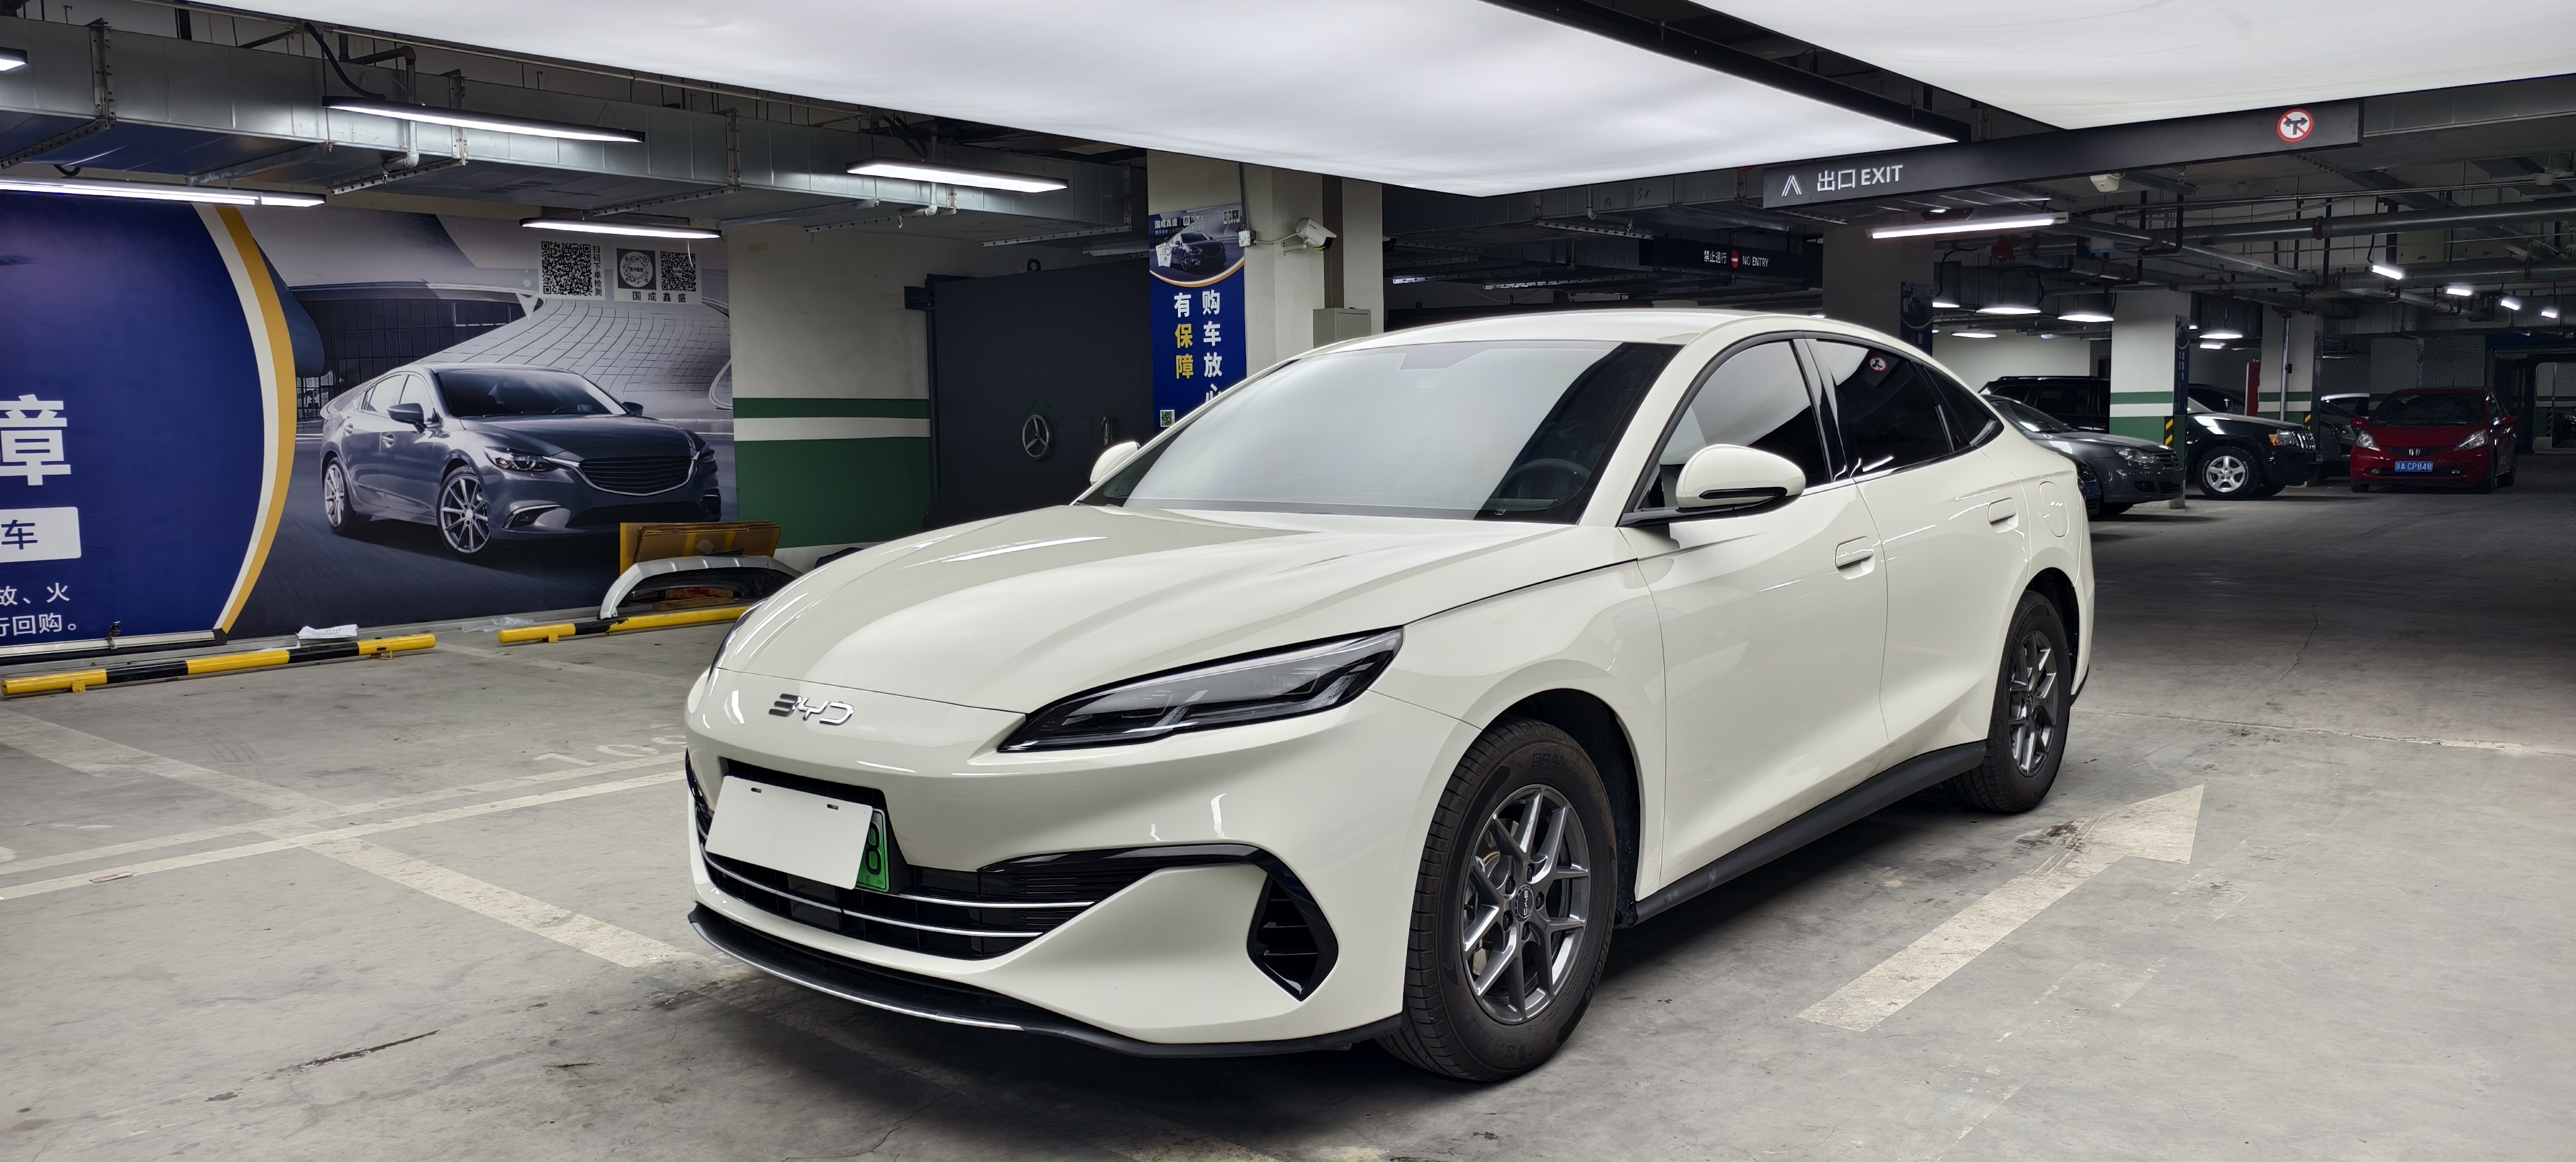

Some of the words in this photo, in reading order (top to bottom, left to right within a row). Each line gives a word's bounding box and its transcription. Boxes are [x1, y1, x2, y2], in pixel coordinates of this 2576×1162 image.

[1817, 170, 1855, 192] 出口
[1861, 164, 1903, 185] EXIT
[1704, 250, 1727, 264] 禁止通行
[1742, 255, 1751, 265] NO
[1752, 256, 1769, 267] ENTRY
[632, 291, 687, 303] 国成鑫盛
[1174, 292, 1194, 379] 有保障
[1, 519, 38, 550] 车
[768, 693, 855, 726] BYD
